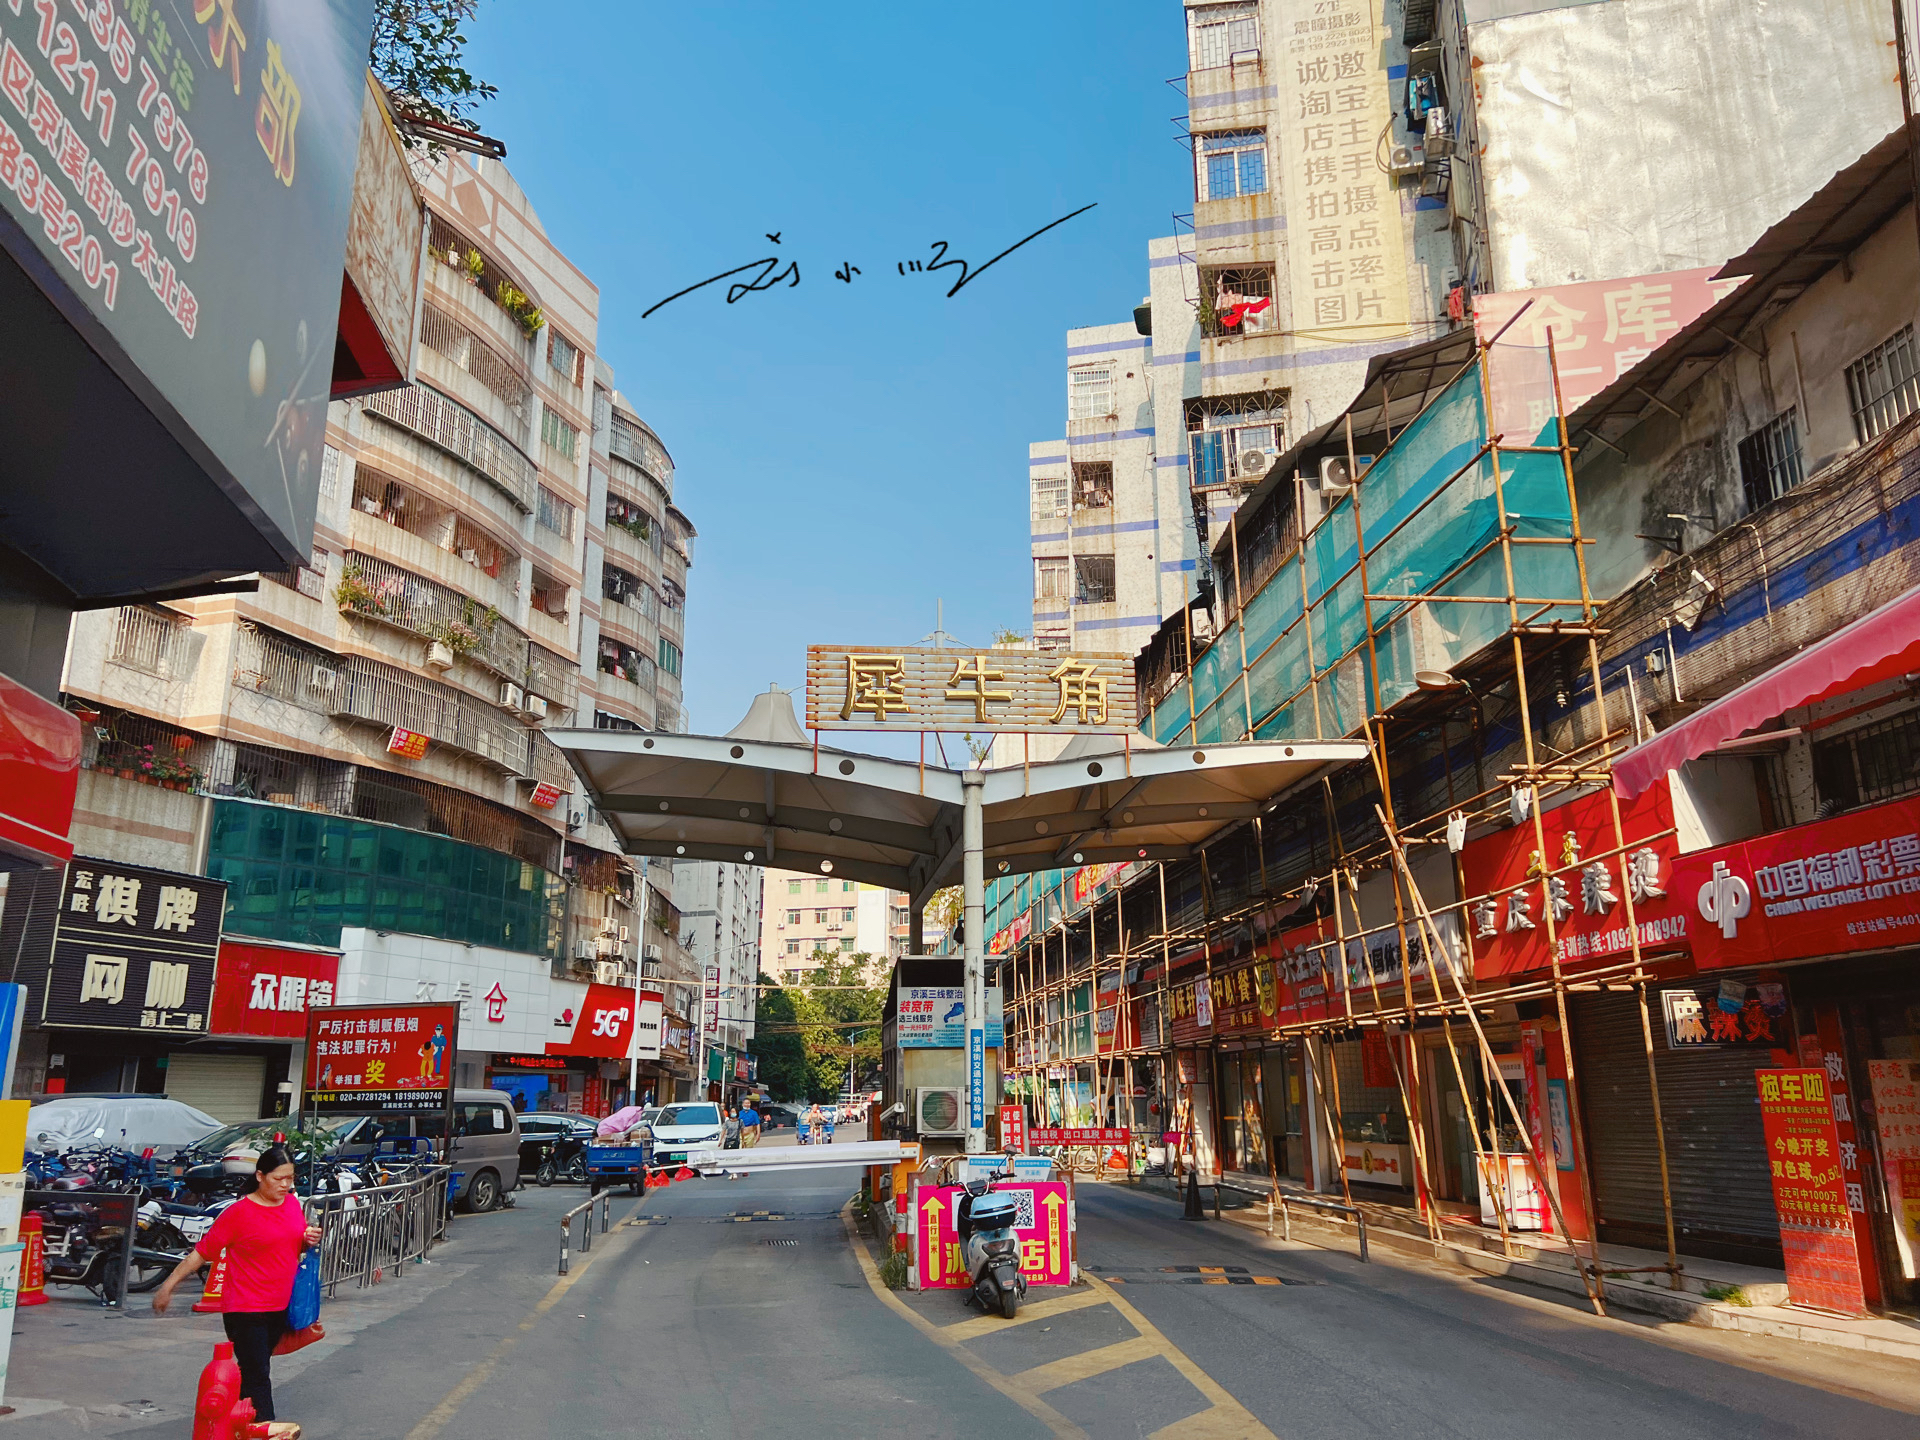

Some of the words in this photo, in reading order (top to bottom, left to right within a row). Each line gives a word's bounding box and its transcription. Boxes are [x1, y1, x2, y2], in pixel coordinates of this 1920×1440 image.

[1297, 51, 1367, 87] 诚邀
[1300, 84, 1370, 119] 淘宝
[137, 56, 208, 204] 7378
[1303, 118, 1373, 153] 店主
[1305, 150, 1375, 187] 携手
[126, 123, 197, 263] 7919
[1307, 184, 1378, 221] 拍摄
[1308, 219, 1382, 256] 高点
[1311, 254, 1385, 290] 击率
[1314, 289, 1387, 326] 图片
[839, 654, 1109, 725] 犀牛角
[1754, 833, 1920, 900] 中国福利彩票
[95, 874, 198, 933] 棋牌
[1765, 898, 1804, 918] CHINA
[1803, 887, 1866, 911] WELFARE
[140, 1010, 203, 1031] 请上二楼
[318, 1017, 419, 1036] 严厉打击制贩假烟
[1672, 996, 1776, 1043] 麻辣烫
[365, 1059, 386, 1085] 奖
[973, 1036, 983, 1121] 京溪街交通安全劝导岗
[1760, 1073, 1826, 1103] 换车啦
[340, 1092, 391, 1102] 020-87281294
[394, 1091, 443, 1101] 18198900740
[1774, 1136, 1830, 1157] 今晚开奖
[1772, 1160, 1813, 1182] 双色球
[1778, 1187, 1839, 1203] 2元可中1000万
